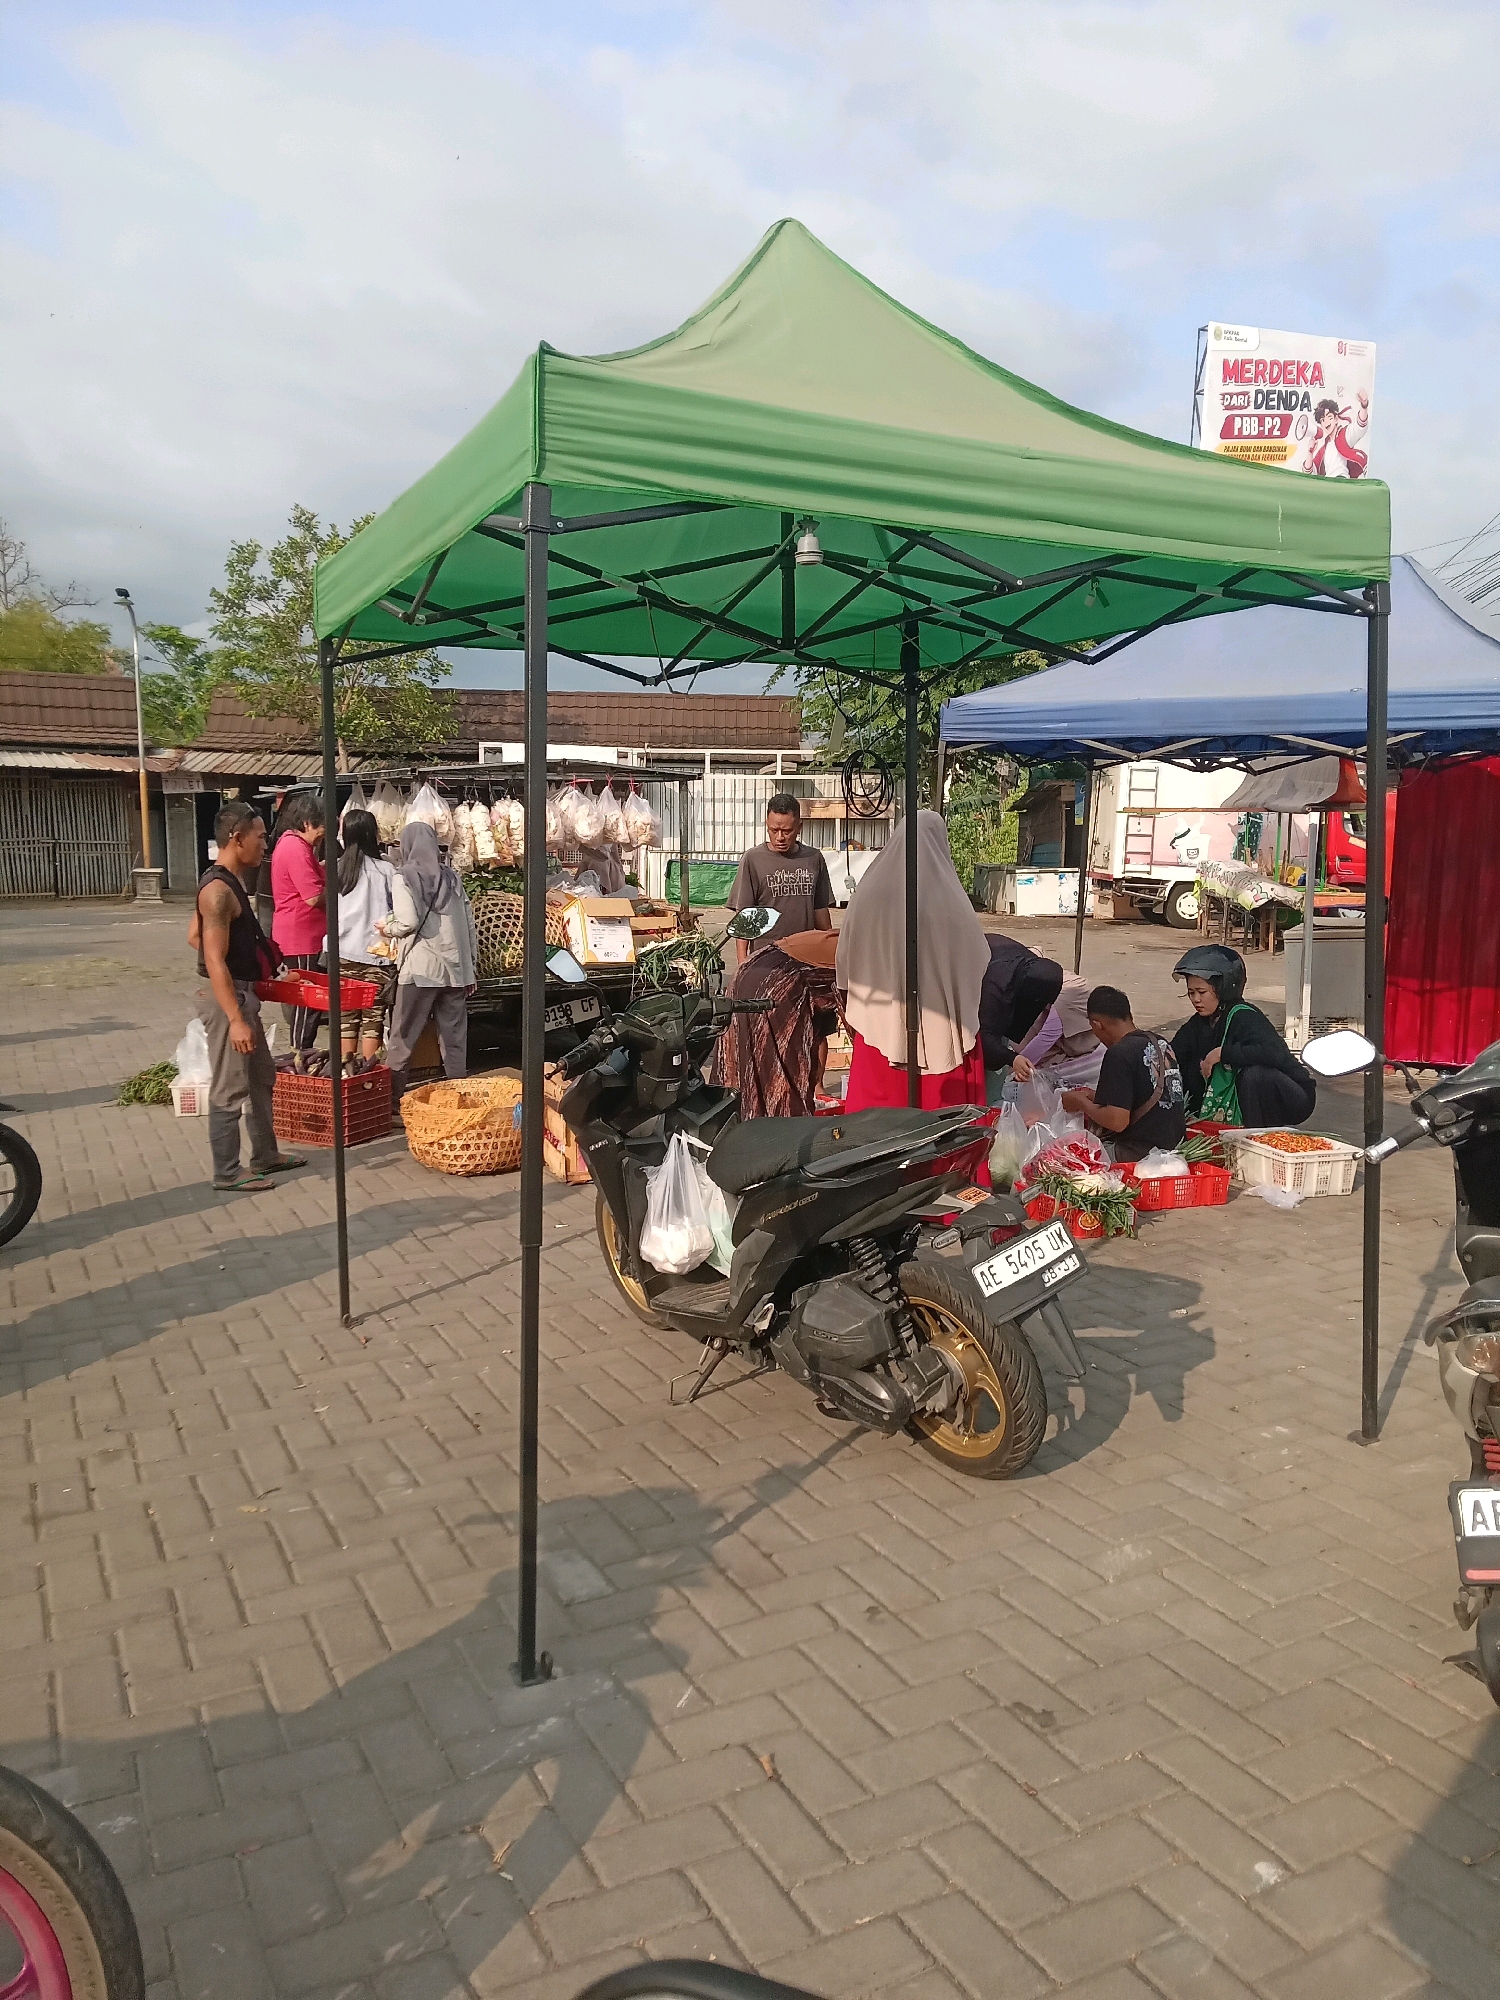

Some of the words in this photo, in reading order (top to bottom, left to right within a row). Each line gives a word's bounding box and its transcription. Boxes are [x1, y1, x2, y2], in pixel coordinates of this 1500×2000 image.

[1222, 358, 1325, 388] MERDEKA
[1223, 394, 1249, 407] DARI
[1253, 389, 1312, 412] DENDA
[1233, 416, 1282, 437] PBB-P2
[1223, 445, 1239, 453] PAJAK
[1252, 445, 1263, 453] DAN
[1263, 445, 1288, 453] BANGUNAN
[772, 884, 814, 897] FIGHTER
[580, 997, 595, 1013] CF
[979, 1264, 1003, 1291] AE
[1005, 1239, 1046, 1275] 5495
[1046, 1226, 1070, 1251] UK
